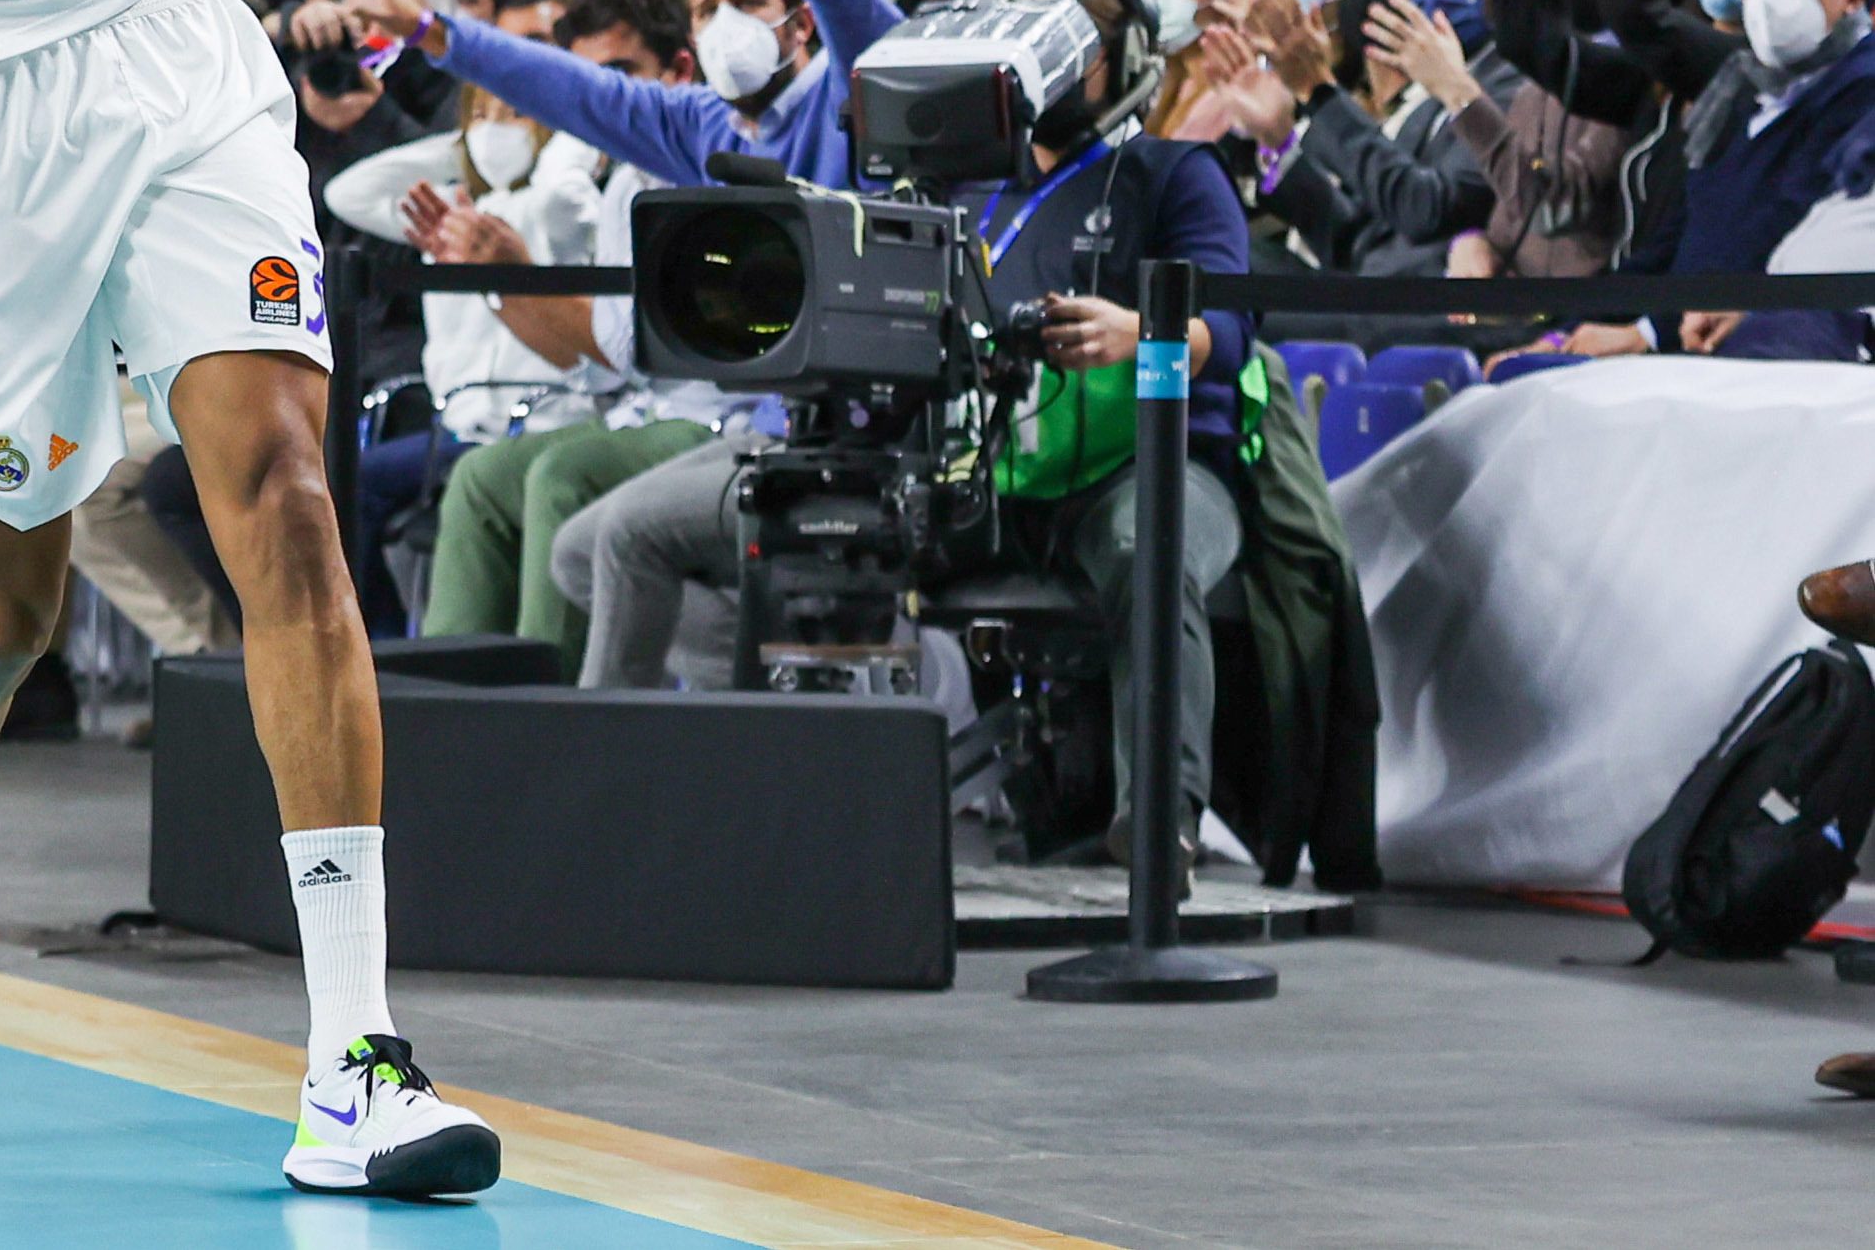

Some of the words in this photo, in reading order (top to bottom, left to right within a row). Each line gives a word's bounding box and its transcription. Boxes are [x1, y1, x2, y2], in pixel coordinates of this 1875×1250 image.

[255, 301, 297, 310] TURKISH
[255, 308, 297, 317] AIRLINES
[298, 874, 352, 887] adidas
